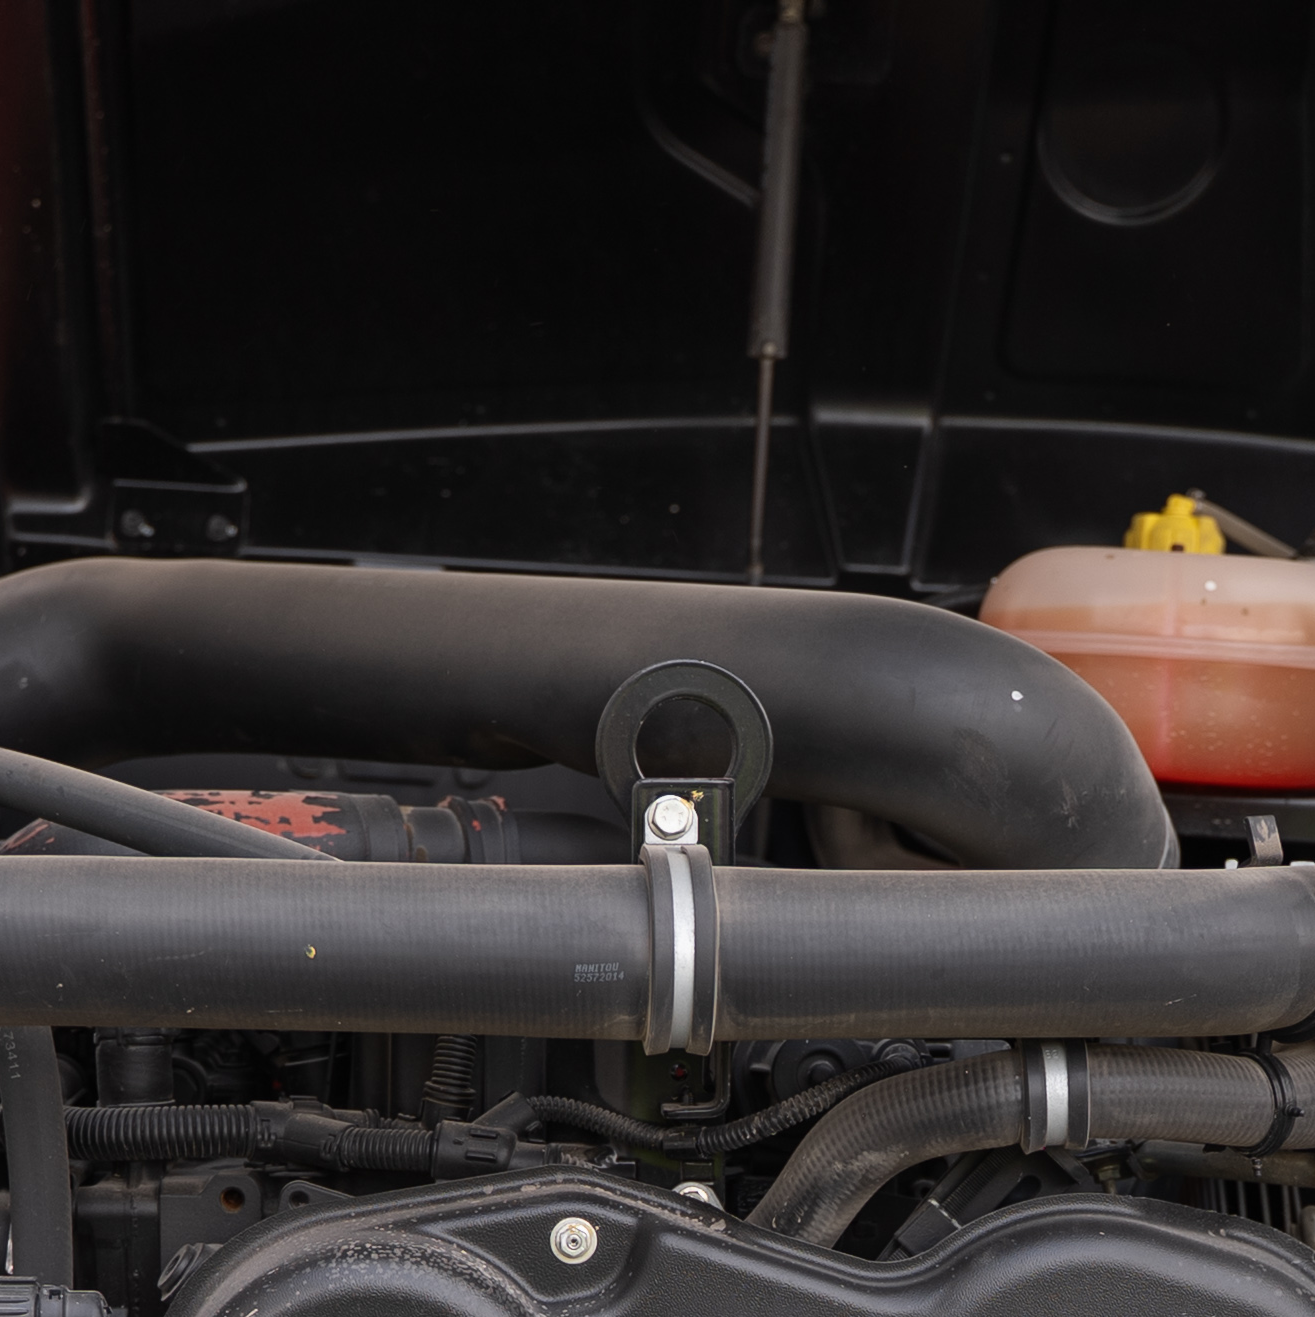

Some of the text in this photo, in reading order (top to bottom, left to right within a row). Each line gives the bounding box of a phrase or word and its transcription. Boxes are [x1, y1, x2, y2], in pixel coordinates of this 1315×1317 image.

[575, 962, 619, 973] MANITOU
[574, 971, 625, 983] 52572014
[3, 1031, 21, 1079] 73411
